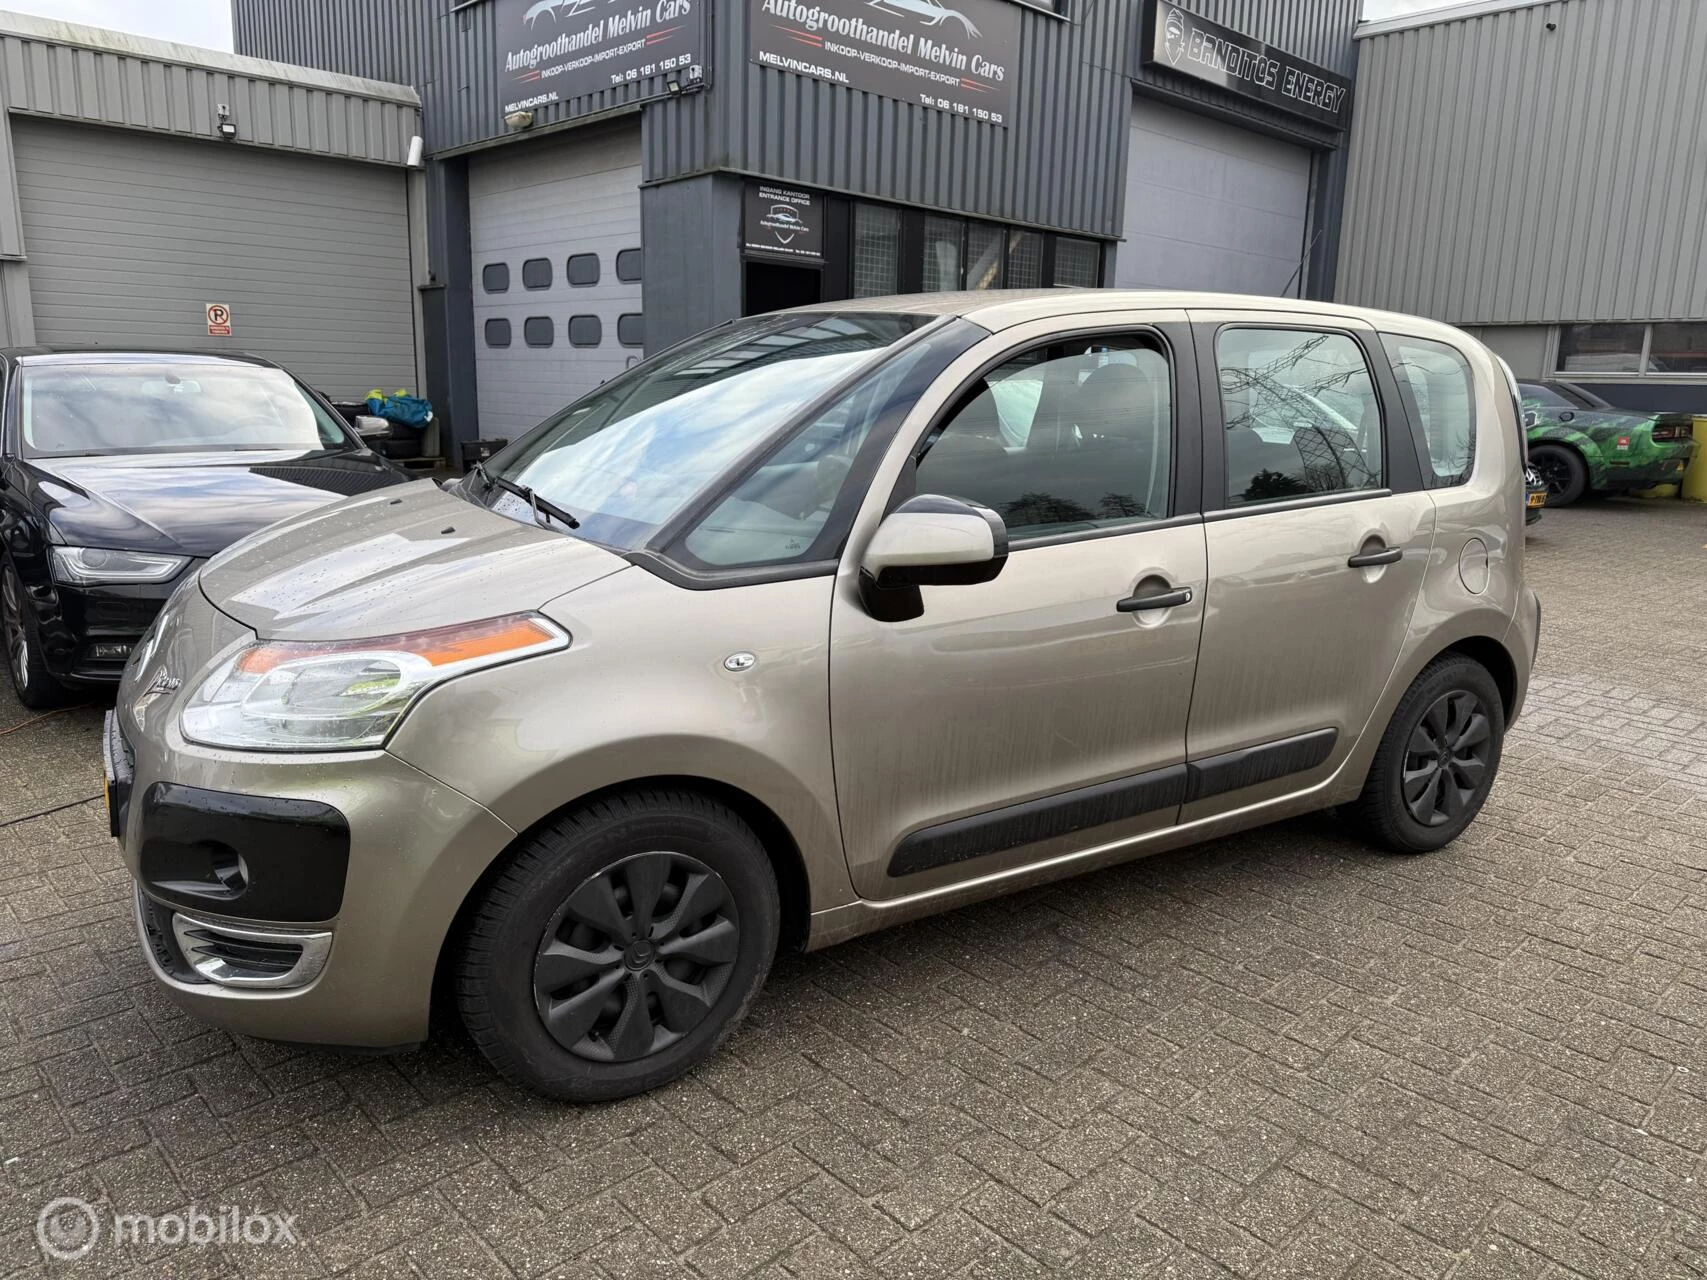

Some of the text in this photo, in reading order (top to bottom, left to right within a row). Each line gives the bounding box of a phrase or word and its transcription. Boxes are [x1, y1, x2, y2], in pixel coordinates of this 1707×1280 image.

[505, 0, 690, 72] Autogroothandel Melvin Cars
[626, 69, 637, 80] 06
[660, 57, 676, 71] 150
[679, 53, 691, 66] 53
[759, 51, 849, 83] MELVINCARS.NL
[917, 37, 967, 71] Melvin
[971, 54, 1005, 81] Cars
[1188, 28, 1345, 113] BANDITOS ENERGY
[505, 91, 558, 113] MELVINCARS.NL
[920, 93, 934, 105] Tel:
[938, 98, 949, 109] 06
[972, 108, 988, 120] 150
[991, 112, 1002, 122] 53
